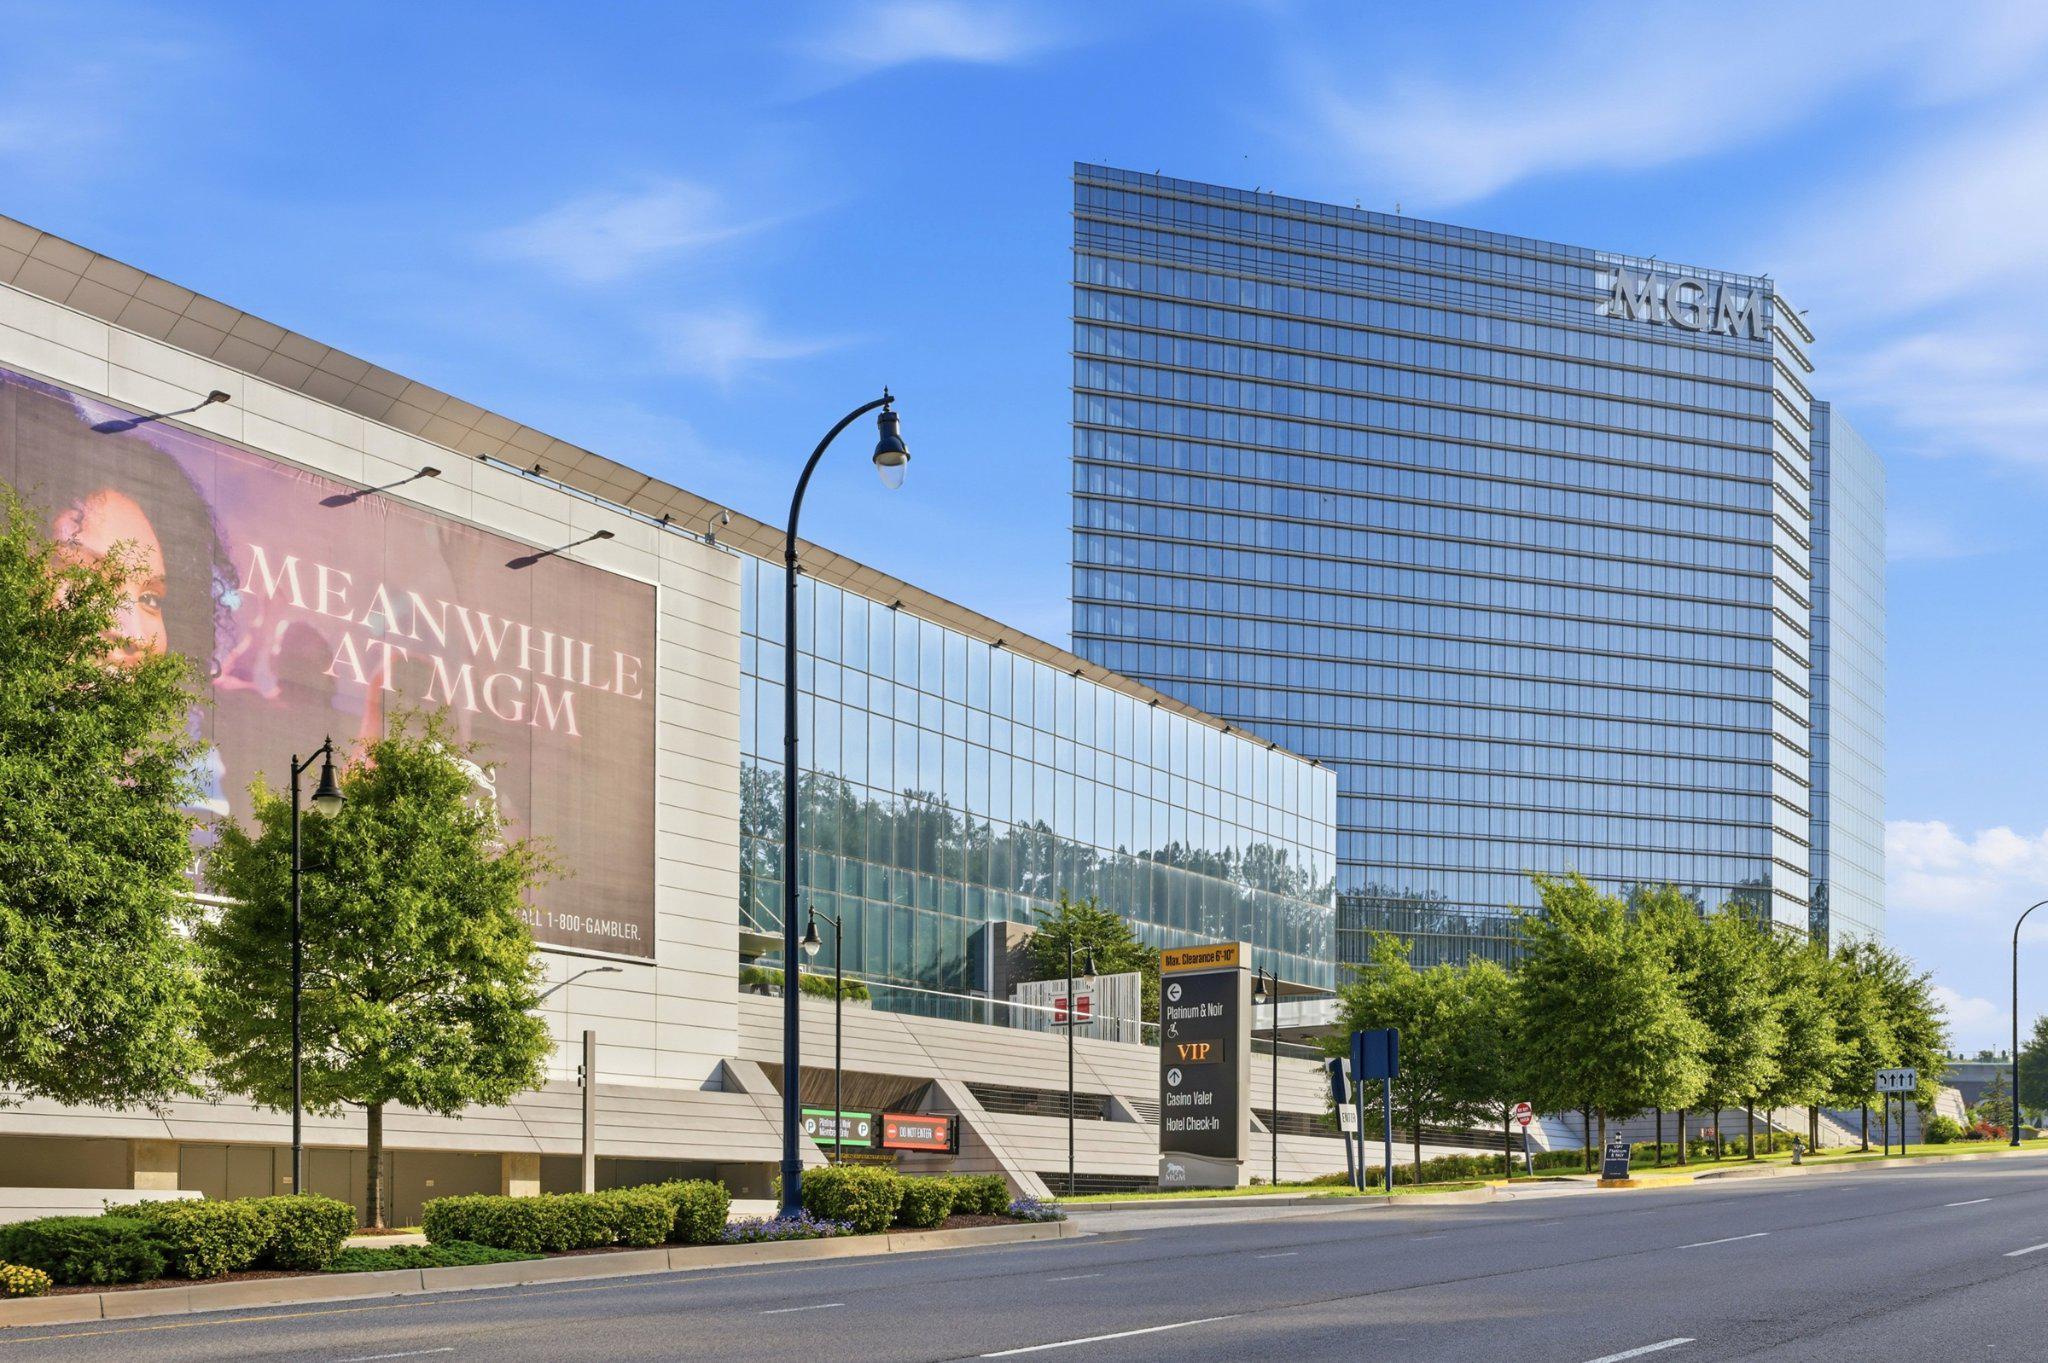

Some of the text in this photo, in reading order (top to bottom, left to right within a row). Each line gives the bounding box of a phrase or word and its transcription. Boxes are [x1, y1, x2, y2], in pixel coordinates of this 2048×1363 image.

[1607, 266, 1766, 341] MGM
[238, 543, 643, 700] MEANWHILE
[323, 631, 582, 737] AT MGM
[547, 912, 641, 941] 1-800-GAMBLER.
[1165, 955, 1181, 967] Max.
[1182, 953, 1215, 965] Clearance
[1167, 1002, 1224, 1020] Platinum & Noir
[1177, 1043, 1210, 1060] VIP
[1166, 1091, 1213, 1106] Casino Valet
[1166, 1116, 1220, 1131] Hotel Check-In
